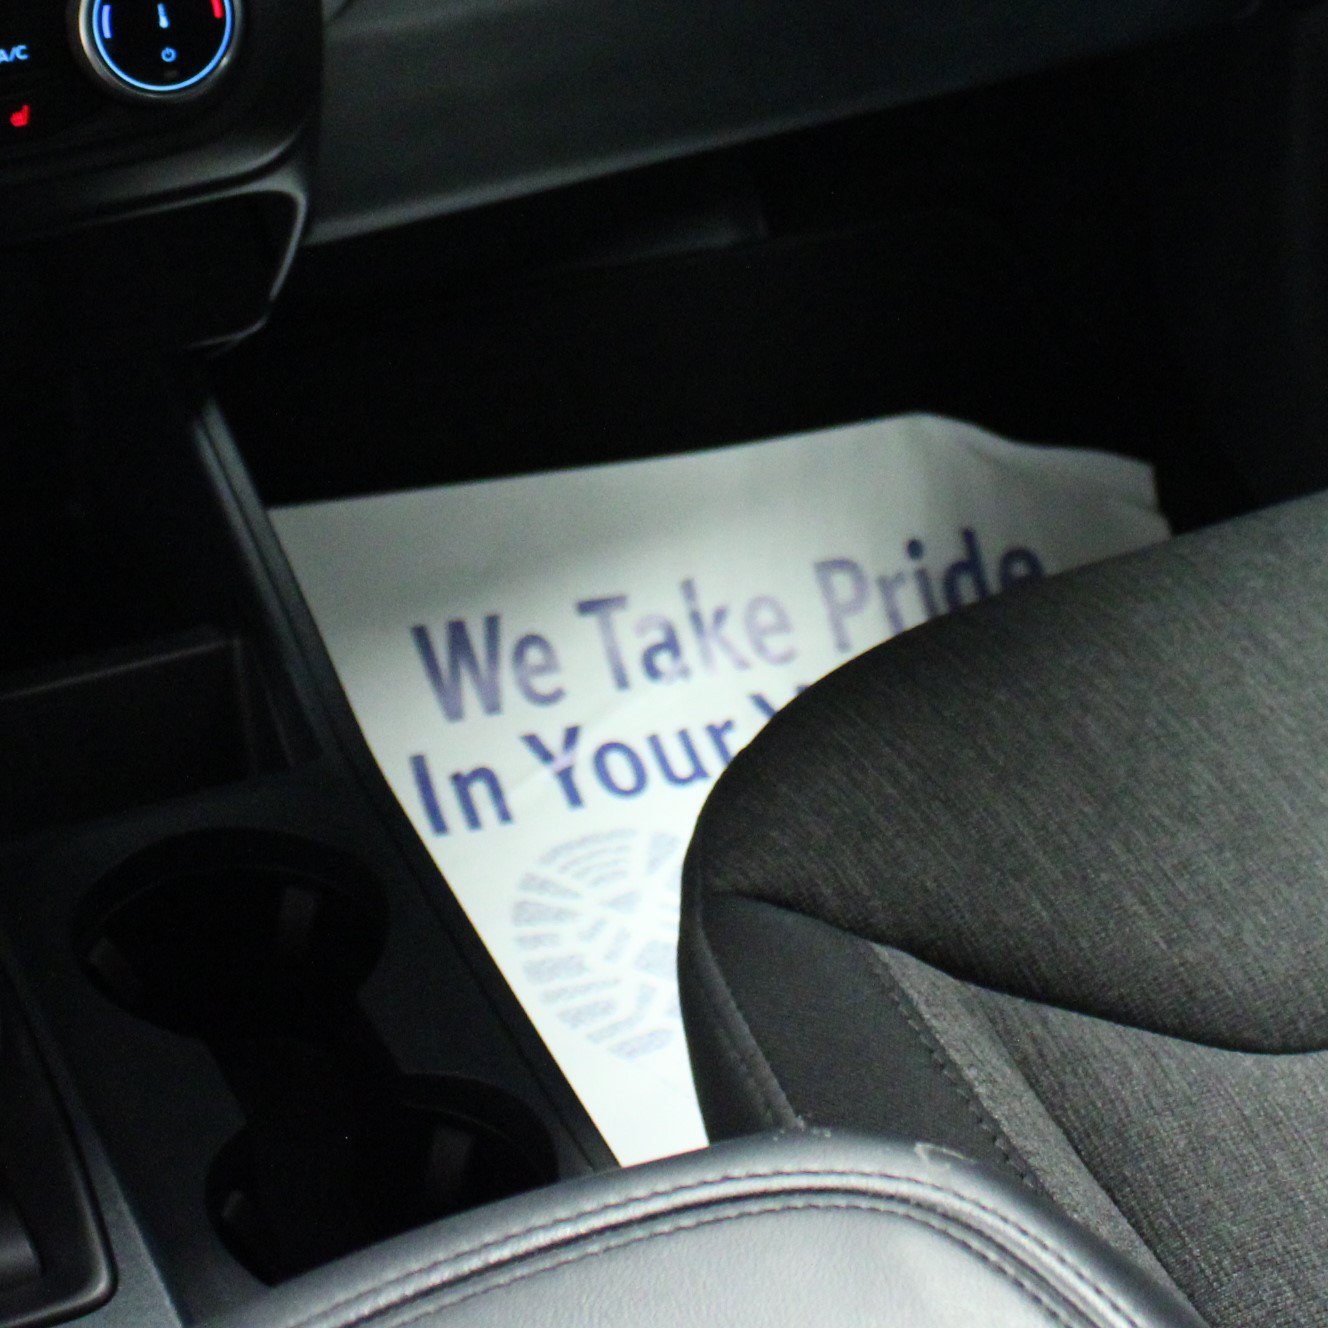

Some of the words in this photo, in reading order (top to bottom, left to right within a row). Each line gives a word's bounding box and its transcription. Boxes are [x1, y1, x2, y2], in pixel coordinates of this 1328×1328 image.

[409, 612, 566, 722] We
[576, 578, 799, 691] Take
[409, 752, 514, 837] In
[520, 720, 735, 810] Your
